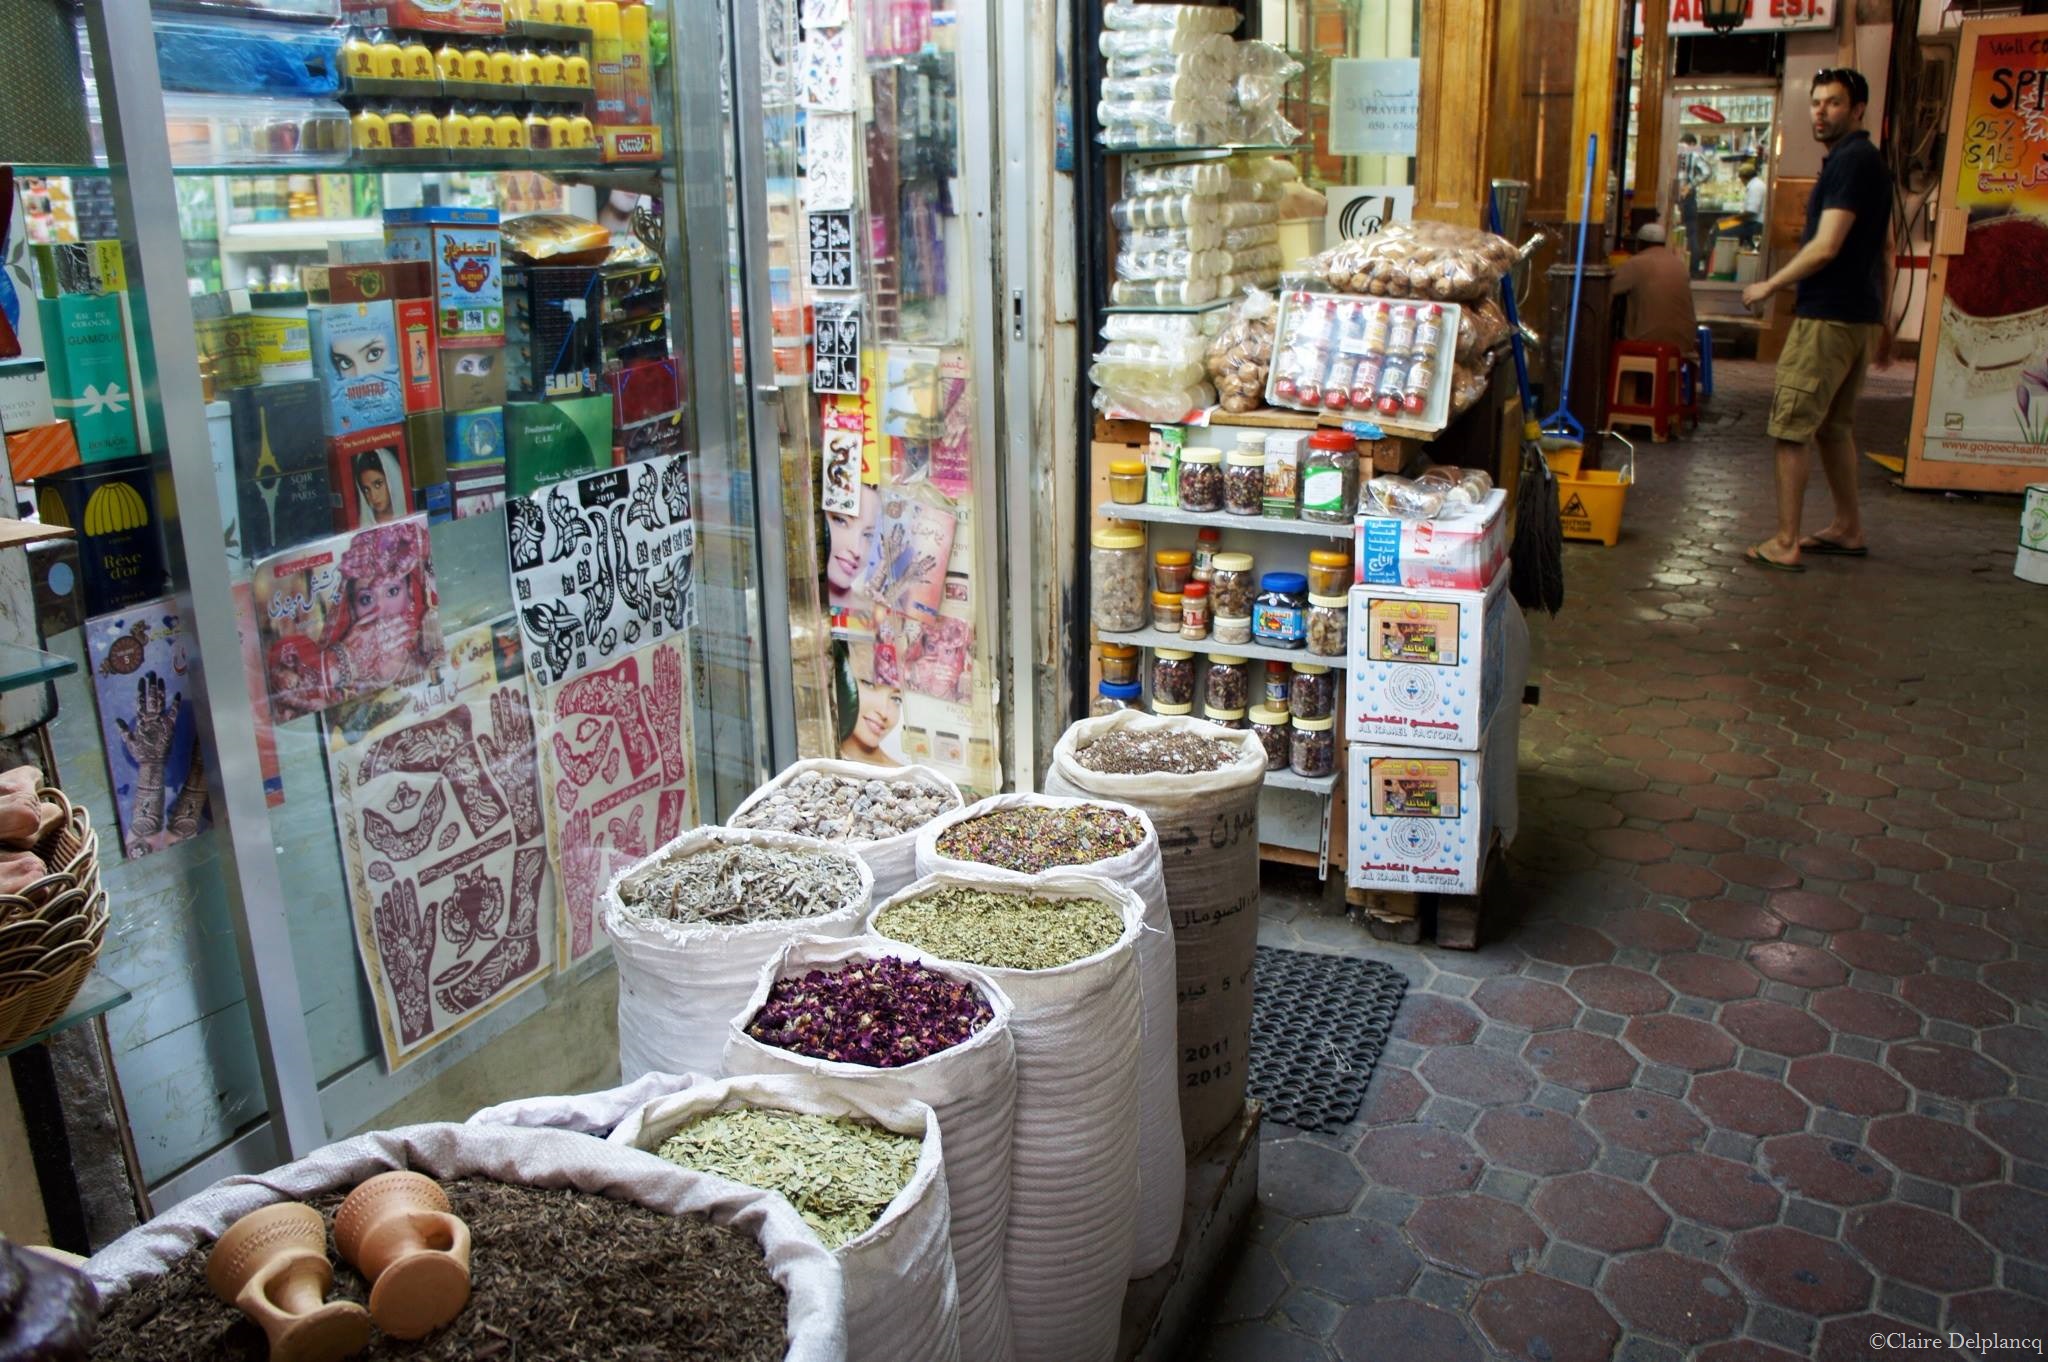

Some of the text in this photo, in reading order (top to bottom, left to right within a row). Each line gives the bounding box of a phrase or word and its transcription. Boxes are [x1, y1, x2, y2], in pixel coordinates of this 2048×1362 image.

[1769, 0, 1823, 18] EST.
[1365, 105, 1408, 115] PRAYER
[1972, 119, 2016, 142] 25%
[1968, 142, 2014, 164] SALE
[1358, 726, 1371, 734] AL
[1375, 726, 1408, 737] KAMEL
[1409, 719, 1459, 731] مصنع
[1362, 873, 1374, 881] AL
[1377, 872, 1410, 883] KAMEL
[1411, 865, 1460, 876] مصنع
[1185, 1036, 1229, 1063] 2011
[1186, 1060, 1232, 1088] 2013
